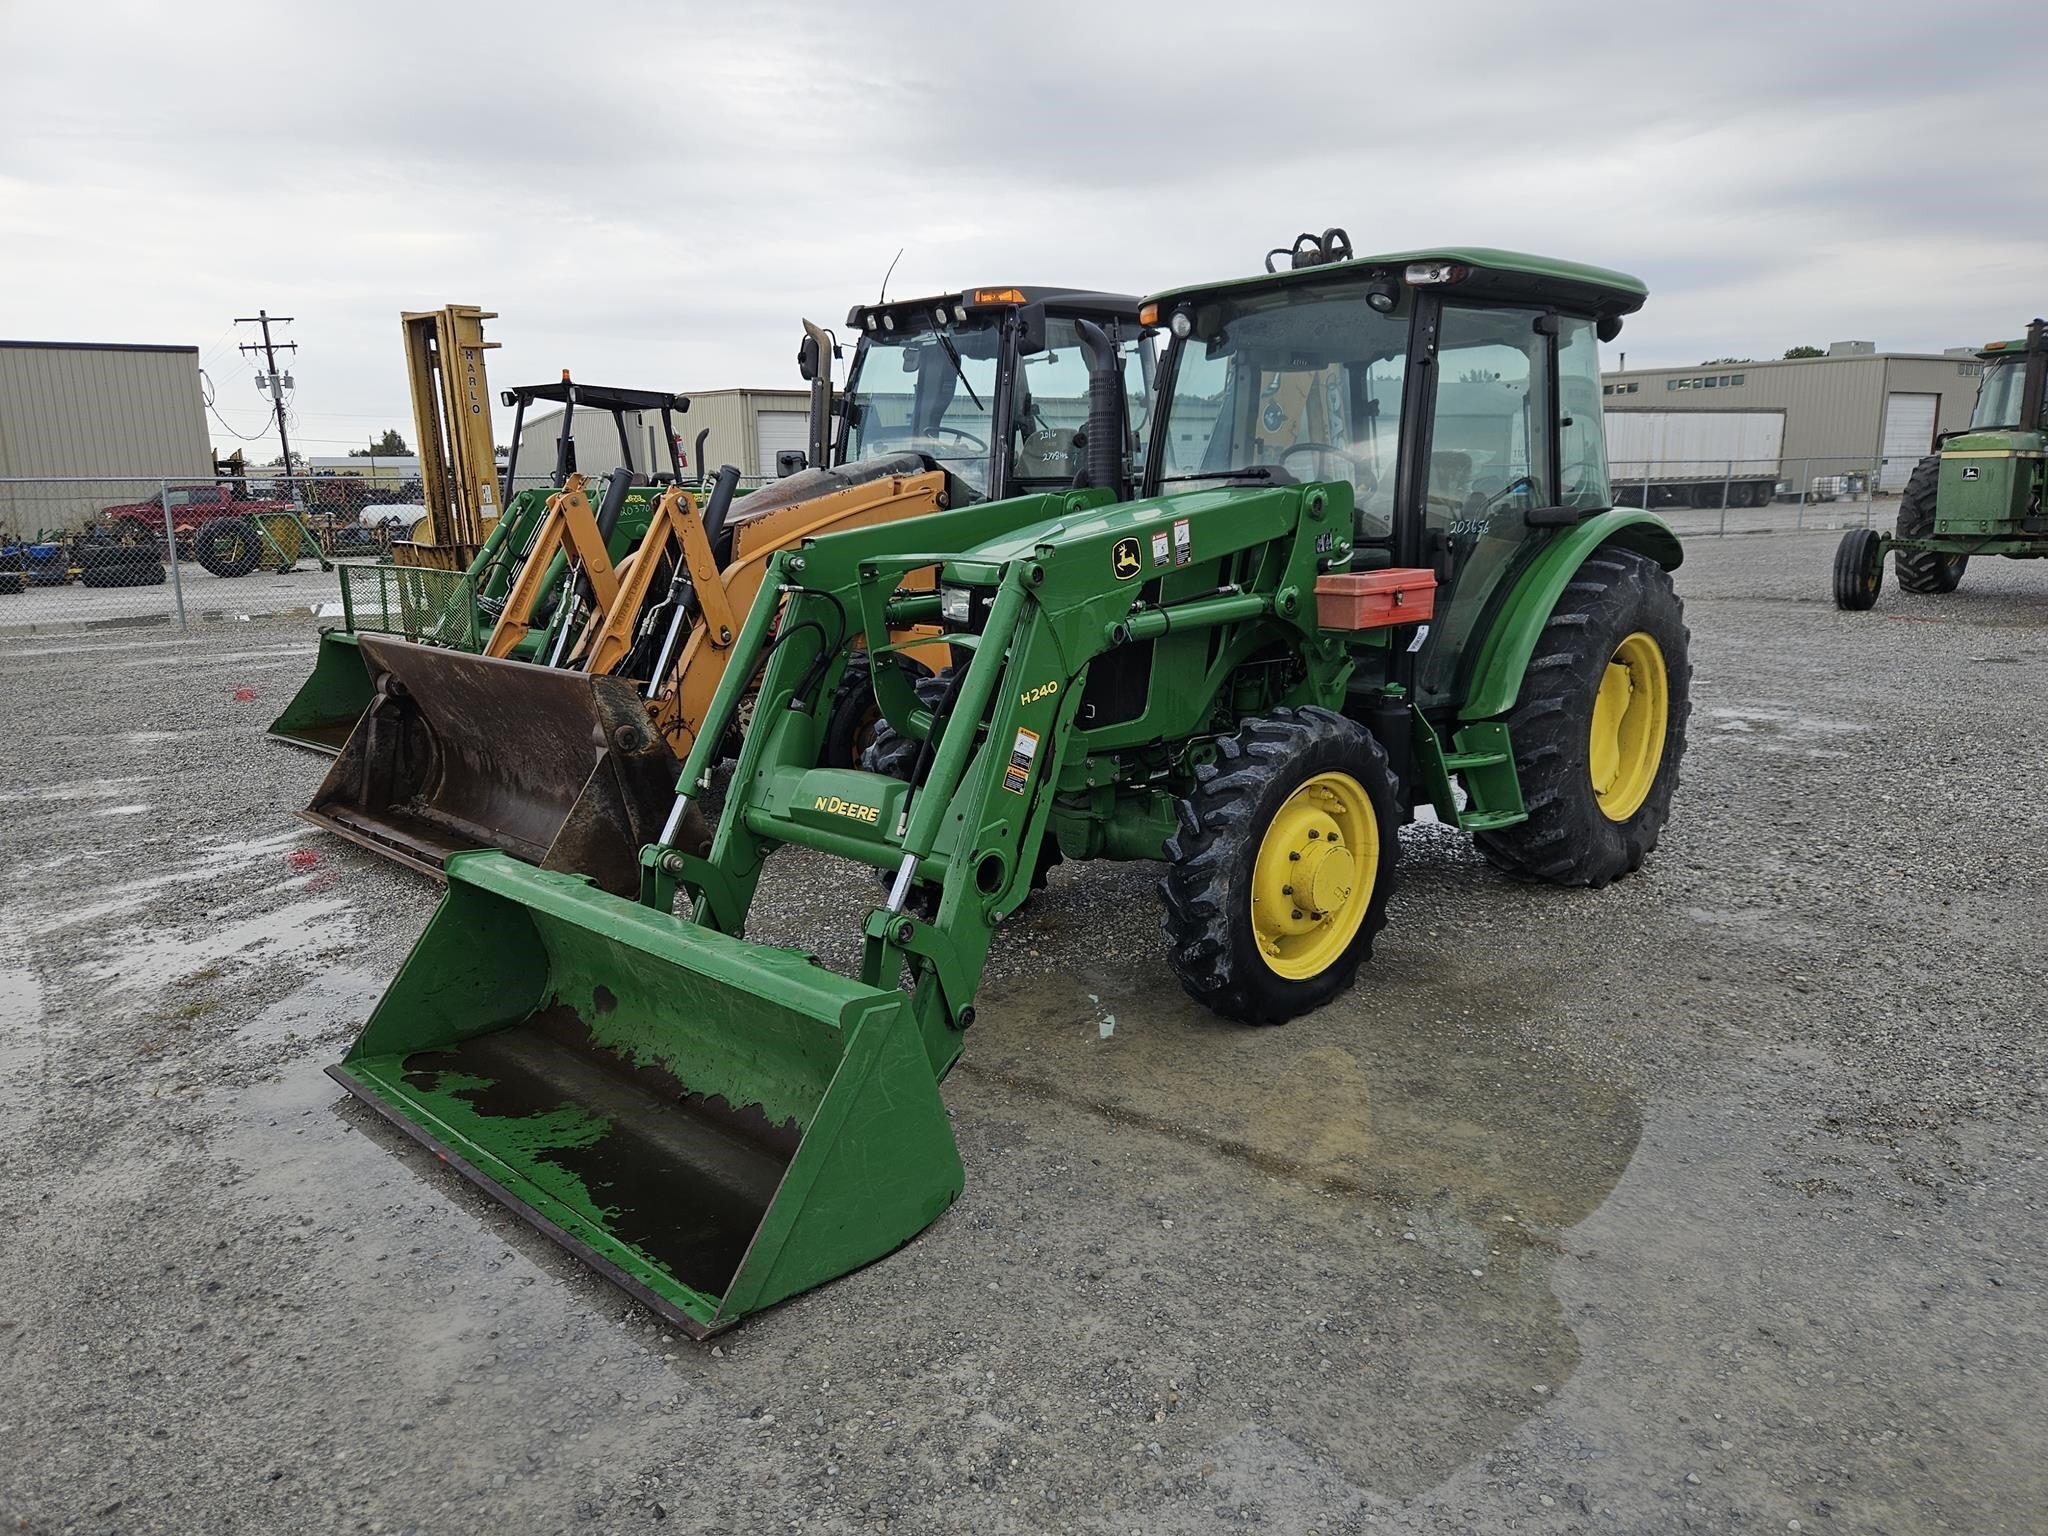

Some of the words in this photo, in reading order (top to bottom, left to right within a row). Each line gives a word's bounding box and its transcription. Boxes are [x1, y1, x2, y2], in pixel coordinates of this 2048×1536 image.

[464, 350, 481, 415] HARLO
[1449, 519, 1489, 535] 203656
[1020, 680, 1058, 706] H240
[827, 796, 880, 822] DEERE
